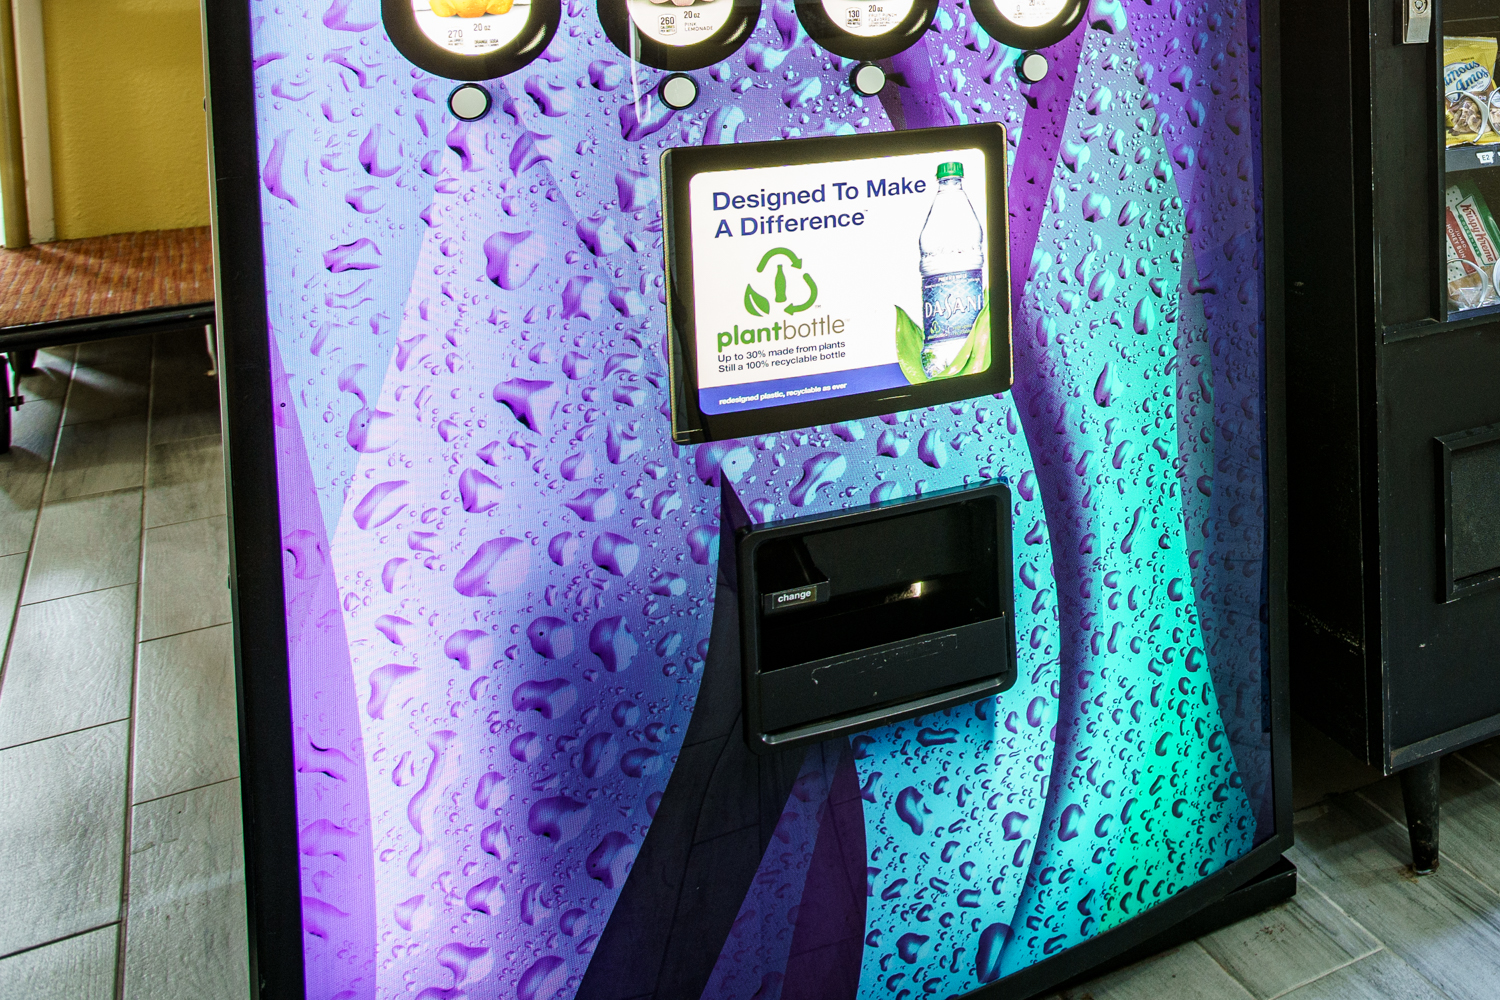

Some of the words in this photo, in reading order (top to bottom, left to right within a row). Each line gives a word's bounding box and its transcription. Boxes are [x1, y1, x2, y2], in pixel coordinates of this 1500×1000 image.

[683, 10, 693, 19] 20
[848, 10, 860, 18] 130
[868, 4, 877, 13] 20
[473, 23, 483, 31] 20
[660, 16, 675, 26] 260
[447, 29, 463, 39] 270
[1456, 68, 1489, 95] Amos
[712, 183, 826, 211] Designed
[832, 182, 859, 201] To
[866, 176, 927, 199] Make
[714, 219, 734, 239] A
[740, 209, 866, 237] Difference
[1459, 203, 1480, 234] Krispy
[1474, 231, 1498, 263] Kreme
[1445, 223, 1459, 245] HONEY
[1455, 243, 1467, 259] BUN
[1454, 228, 1467, 249] JUMBO
[924, 293, 981, 321] DASANI
[716, 314, 846, 354] plantbottle
[717, 354, 732, 364] Up
[734, 353, 744, 361] to
[746, 350, 767, 360] 30%
[768, 347, 794, 357] made
[795, 344, 818, 355] from
[818, 340, 846, 353] plants
[718, 363, 736, 373] Still
[745, 361, 770, 370] 100%
[771, 354, 818, 368] recyclable
[819, 350, 846, 361] bottle
[718, 394, 760, 406] redesigned
[759, 391, 786, 402] plastic,
[786, 386, 822, 397] recyclable
[777, 589, 812, 604] change
